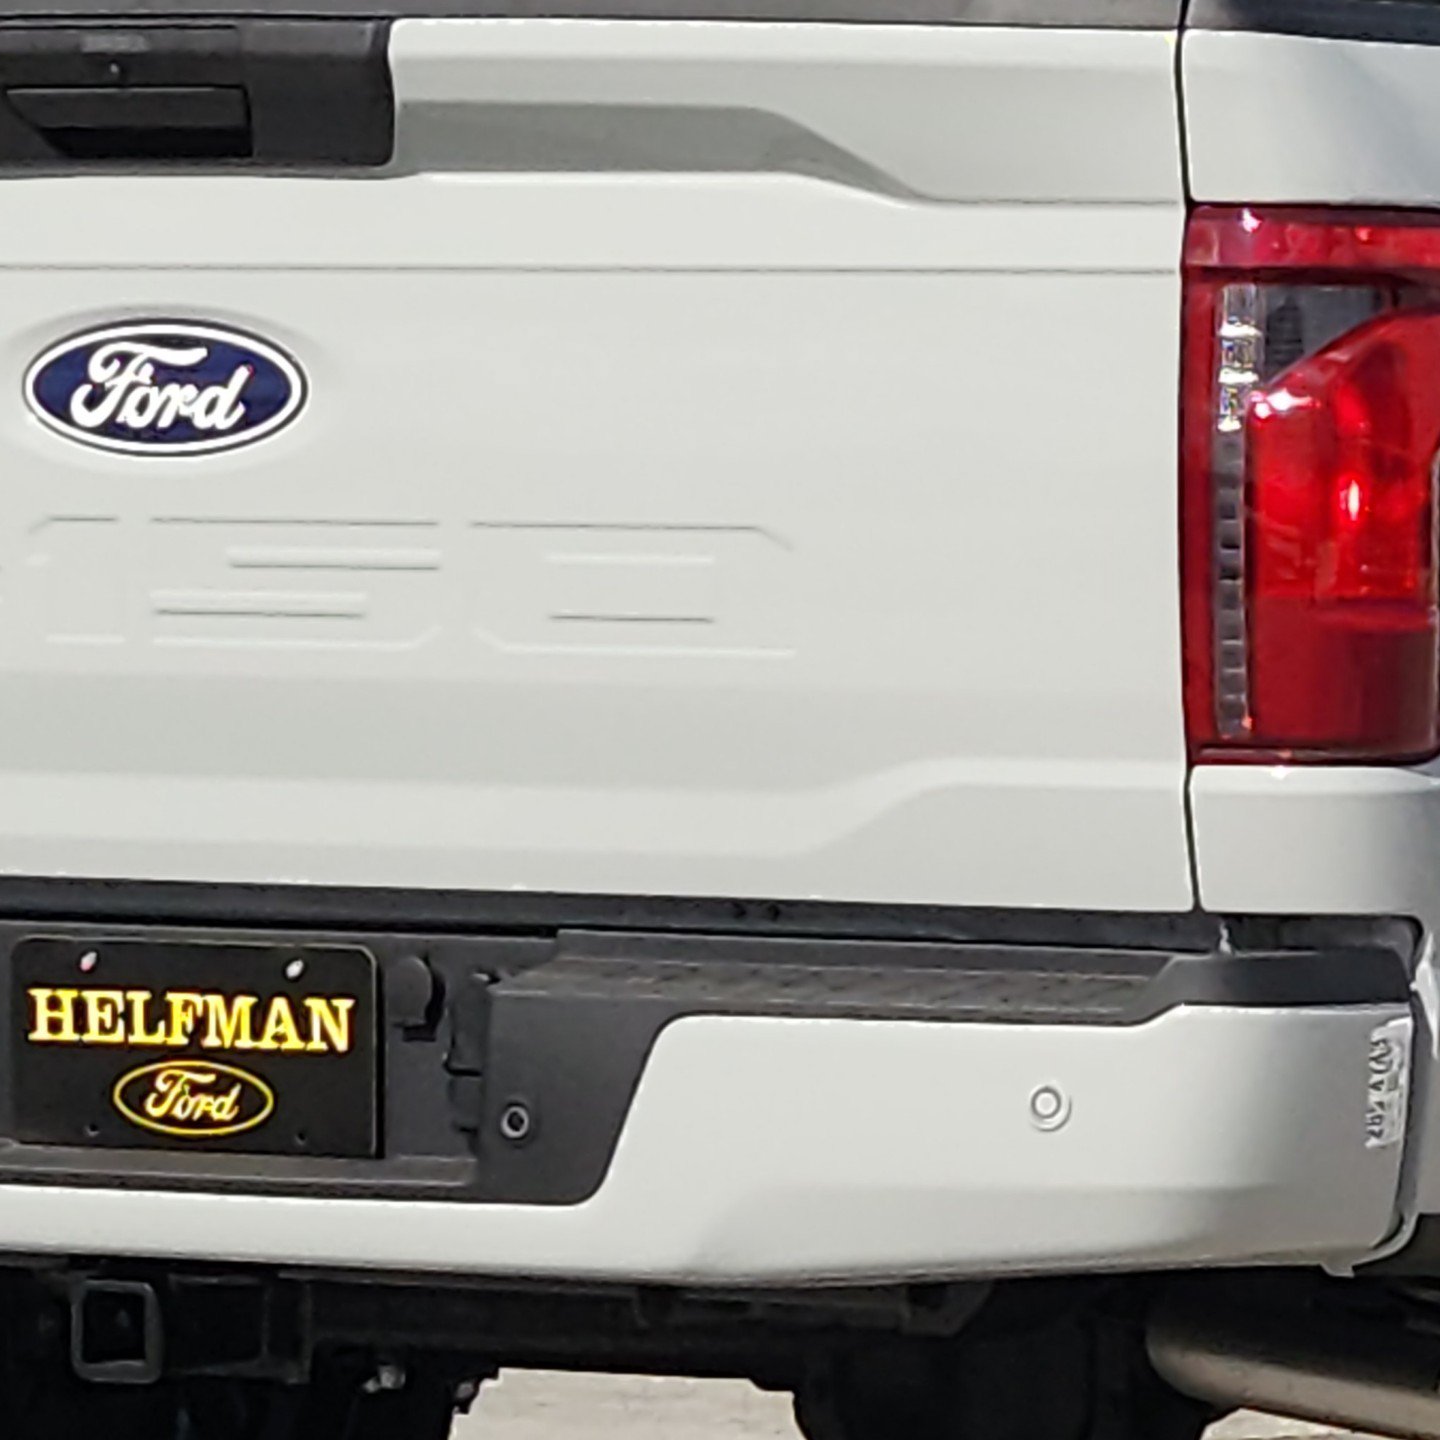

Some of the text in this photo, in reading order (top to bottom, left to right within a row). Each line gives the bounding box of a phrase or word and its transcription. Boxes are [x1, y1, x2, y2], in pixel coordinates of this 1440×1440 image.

[70, 341, 254, 430] Ford
[27, 987, 356, 1052] HELFMAN
[145, 1068, 242, 1121] Ford
